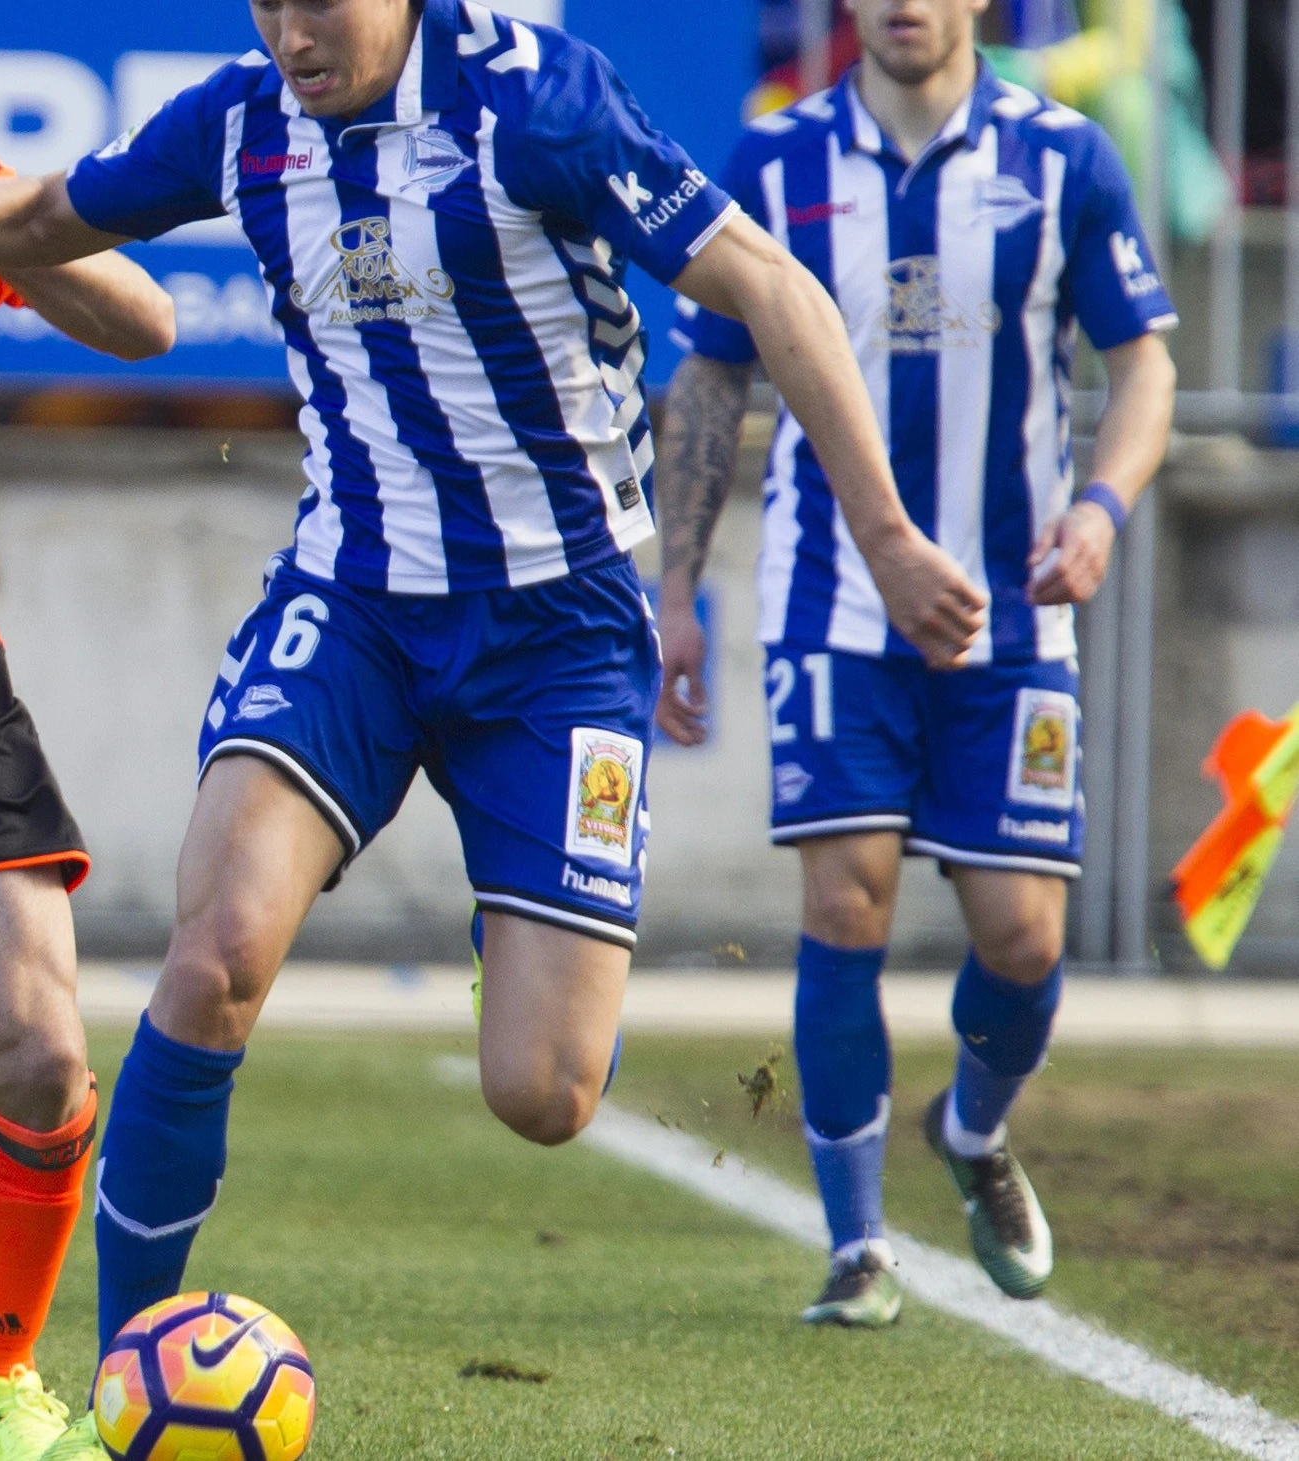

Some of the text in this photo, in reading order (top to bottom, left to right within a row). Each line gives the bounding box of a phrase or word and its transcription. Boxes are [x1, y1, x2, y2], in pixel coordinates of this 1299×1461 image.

[242, 146, 313, 174] hummel
[342, 254, 400, 282] RIOJA
[329, 278, 425, 302] ALAVESA
[269, 593, 330, 669] 6
[765, 652, 835, 741] 21
